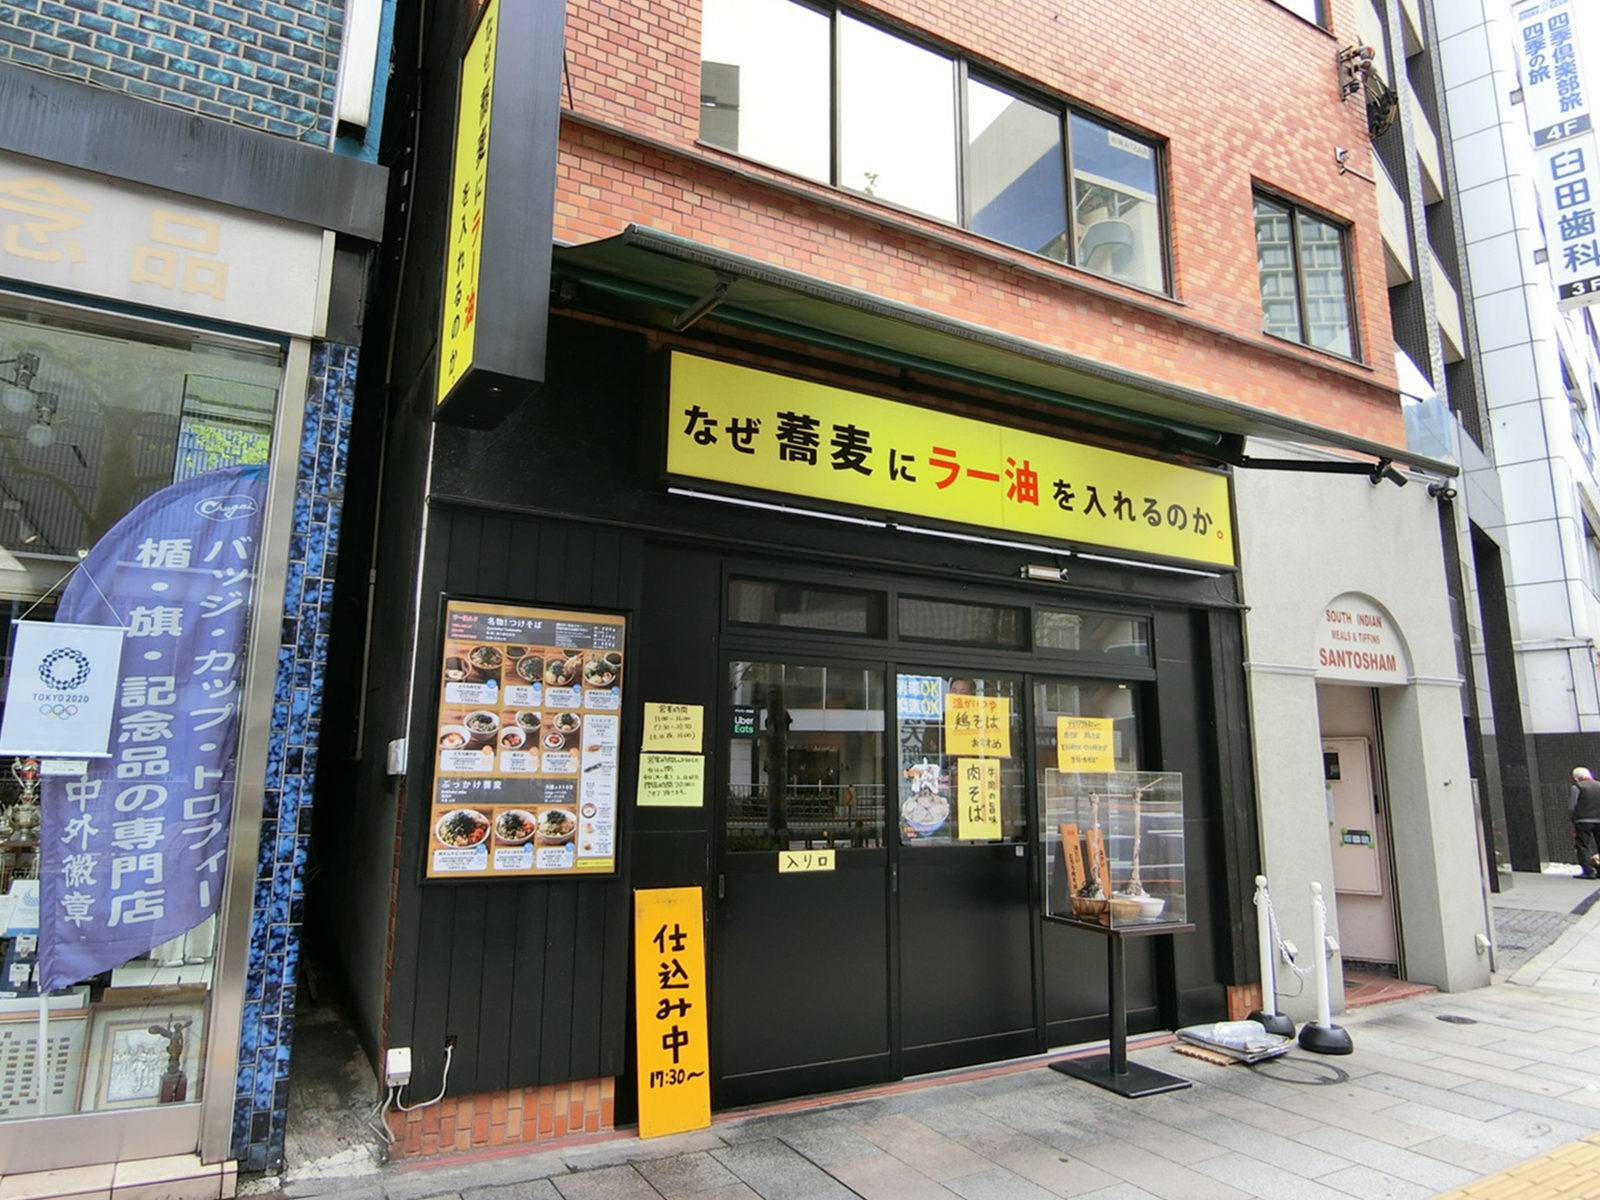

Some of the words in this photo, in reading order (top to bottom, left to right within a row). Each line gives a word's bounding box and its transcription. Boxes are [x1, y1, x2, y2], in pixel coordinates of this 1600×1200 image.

[1522, 21, 1551, 86] 四季の旅
[1547, 119, 1578, 140] 4F
[1550, 147, 1600, 273] 臼田歯科
[200, 498, 255, 519] Chugai
[1325, 609, 1352, 625] SOUTH
[1356, 613, 1382, 628] INDIAN
[1331, 629, 1351, 641] MEALS
[1352, 632, 1357, 643] &
[1358, 632, 1380, 645] TIFFINS
[1319, 648, 1397, 672] SANTOSHAM
[32, 692, 64, 703] TOKYO
[65, 693, 90, 703] 2020
[182, 536, 252, 908] バッジ・カップ・トロフィー
[734, 716, 754, 725] Uber
[734, 724, 754, 734] Eats
[955, 712, 1000, 730] 鶏そば
[107, 538, 192, 927] 楯・旗・記念品の専門店
[966, 763, 986, 823] 肉そば
[60, 774, 102, 928] 中外徽章
[786, 854, 829, 869] 入り口
[652, 923, 693, 1064] 仕込み中
